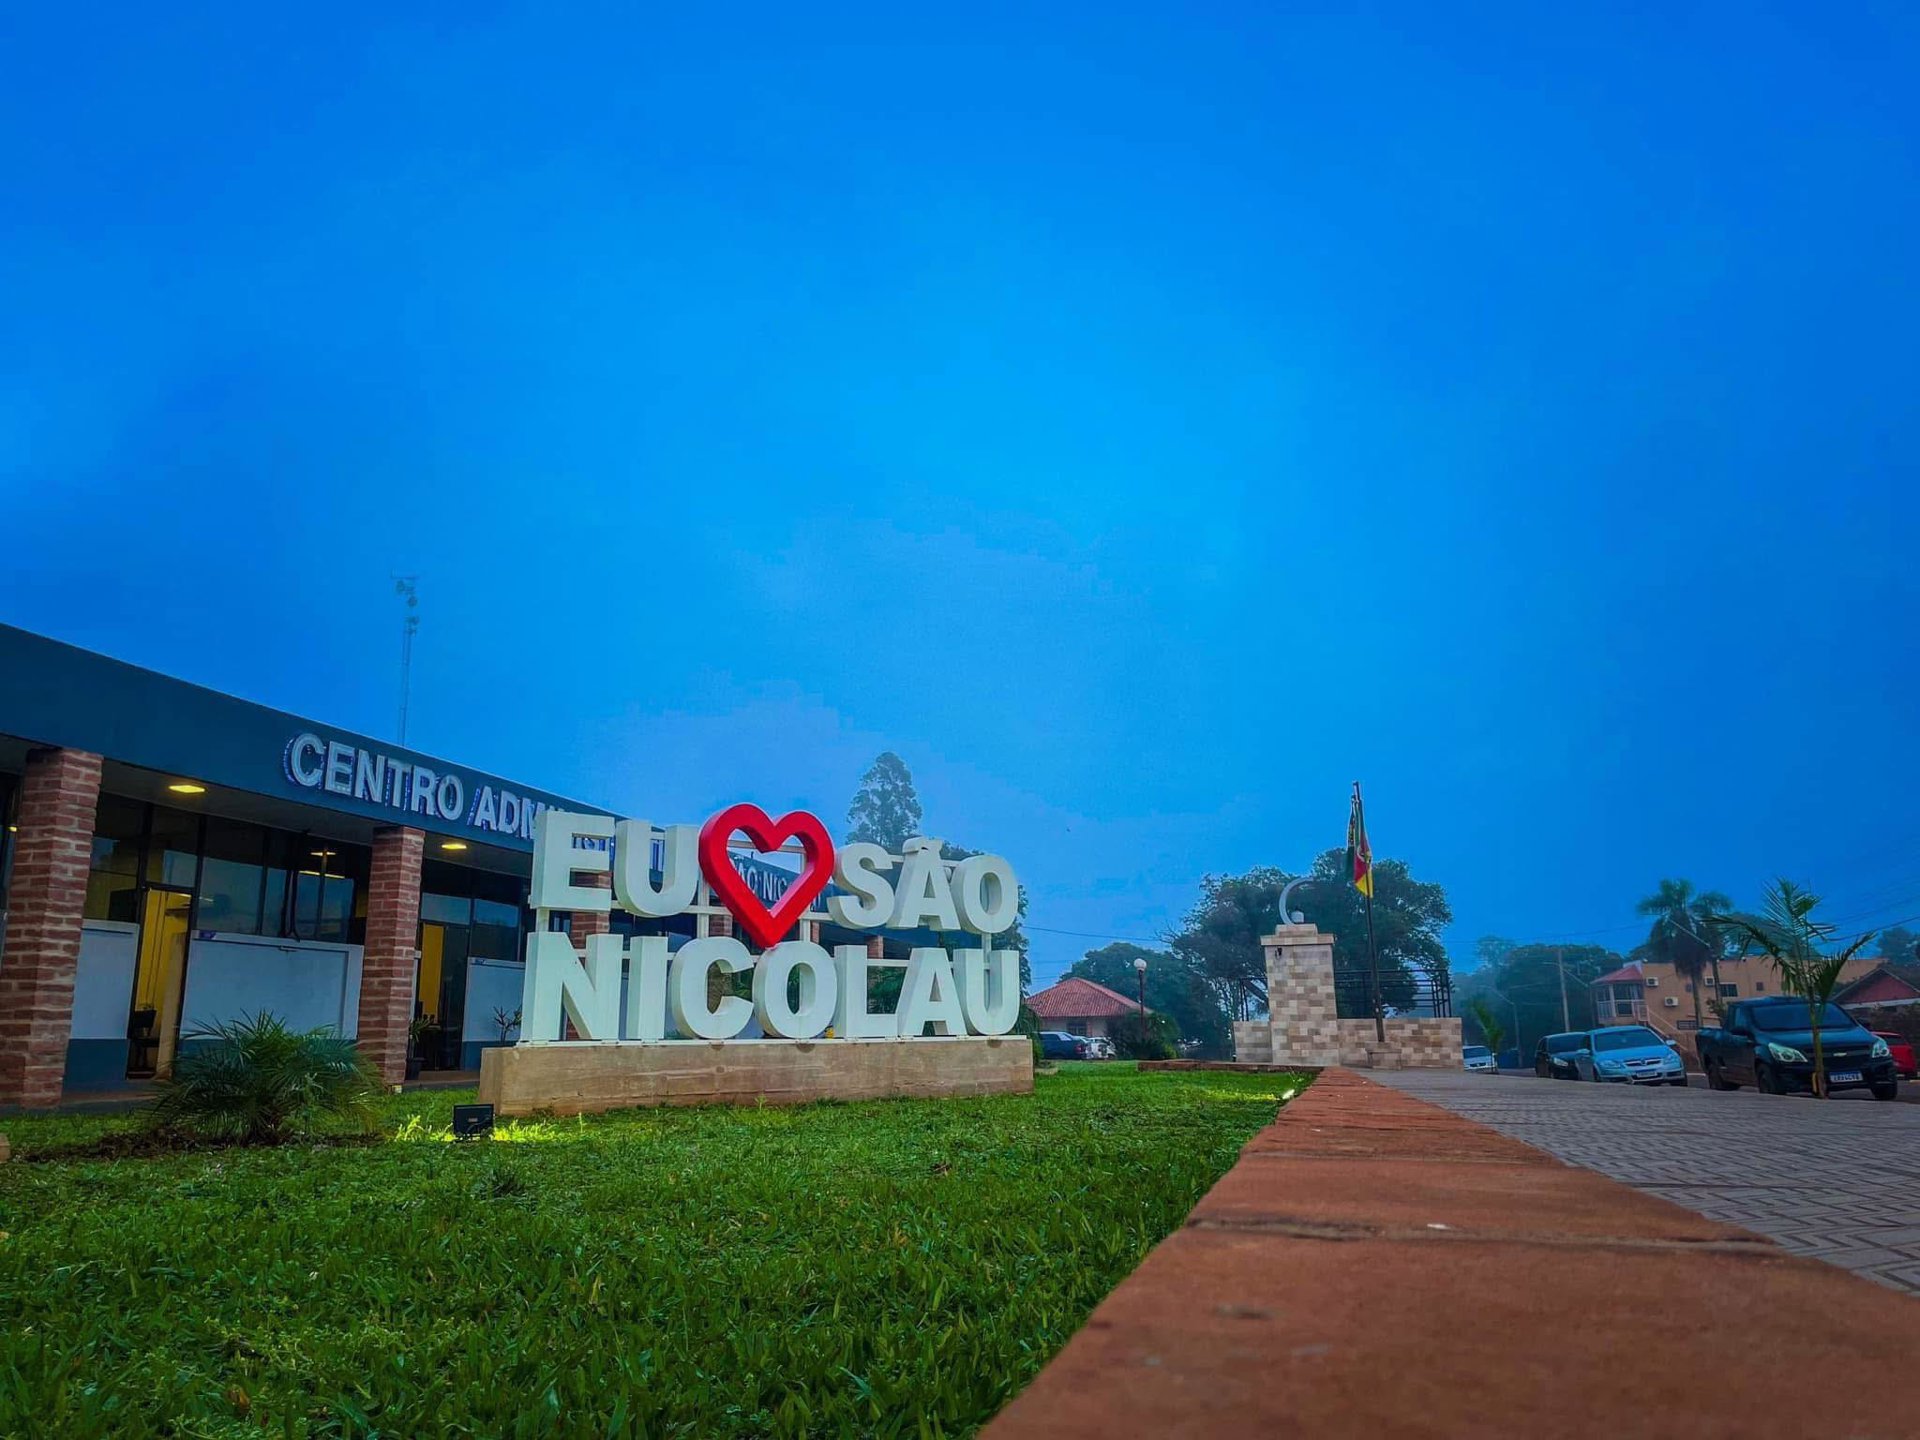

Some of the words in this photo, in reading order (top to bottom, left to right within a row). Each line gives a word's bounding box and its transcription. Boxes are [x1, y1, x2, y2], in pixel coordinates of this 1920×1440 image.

[286, 733, 464, 820] CENTRO
[531, 810, 698, 917] EU
[827, 836, 1020, 934] SÃO
[520, 931, 1020, 1041] NICOLAU
